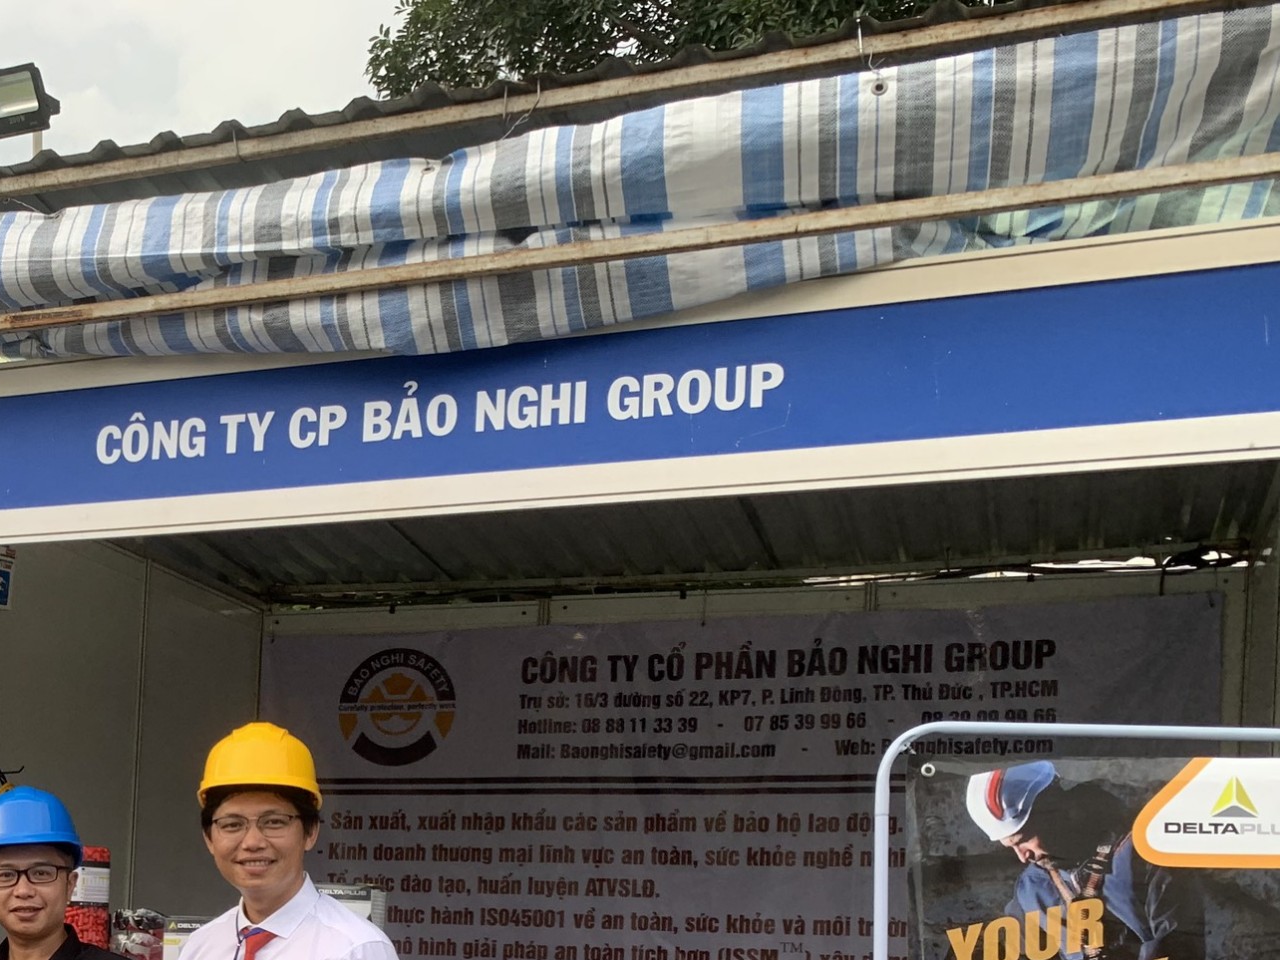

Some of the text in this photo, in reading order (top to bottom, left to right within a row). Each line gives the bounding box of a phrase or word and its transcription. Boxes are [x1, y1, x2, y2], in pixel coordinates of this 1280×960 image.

[96, 362, 785, 465] CÔNG TY CP BẢO NGHI GROUP
[370, 652, 450, 692] NGHI SAFETY
[521, 638, 1057, 684] CÔNG TY CỔ BẢO NGHI GROUP
[762, 680, 1059, 705] P. Linh TP. Thủ Đức TP.HCM
[517, 712, 867, 734] Hotline: 66
[516, 738, 876, 760] Mail: Web:
[330, 809, 840, 837] Sản xuất nhập sản bảo hộ lao
[1163, 821, 1280, 836] DELTAPLU
[328, 842, 797, 869] Kinh doanh mại an toàn, khỏe
[400, 872, 579, 900] đào huấn luyện
[387, 905, 425, 928] thực
[430, 905, 475, 926] hành
[573, 907, 596, 929] về
[601, 912, 624, 930] an
[631, 911, 678, 934] toàn,
[726, 912, 776, 935] khỏe
[782, 915, 806, 936] và
[812, 914, 851, 937] môi
[418, 937, 457, 957] hình
[463, 937, 497, 959] giải
[554, 944, 578, 960] an
